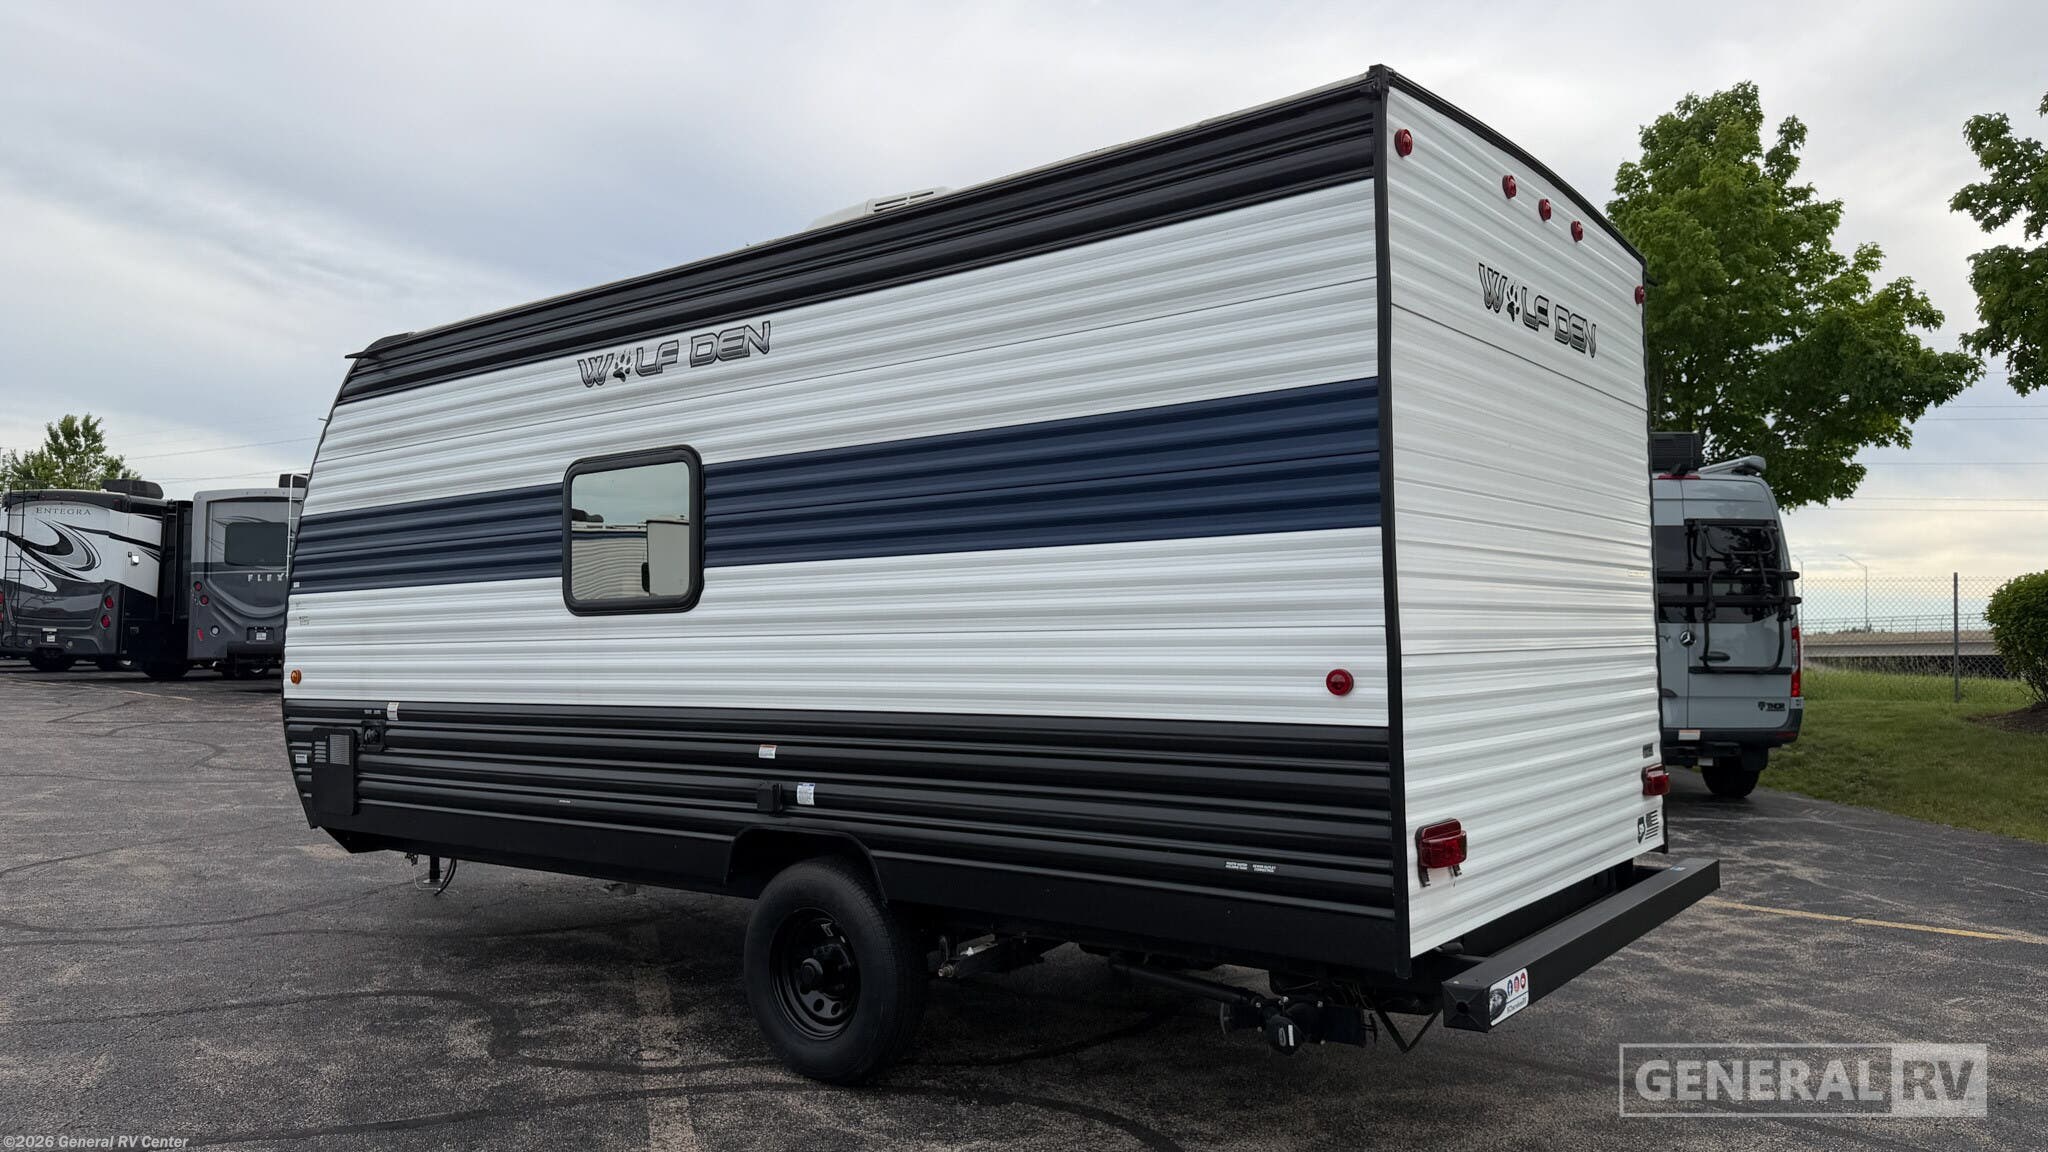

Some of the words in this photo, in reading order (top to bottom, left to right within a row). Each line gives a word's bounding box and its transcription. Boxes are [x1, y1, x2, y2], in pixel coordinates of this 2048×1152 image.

[690, 320, 771, 367] DEN
[1554, 304, 1597, 358] DEN
[35, 506, 92, 516] ENTEGRA
